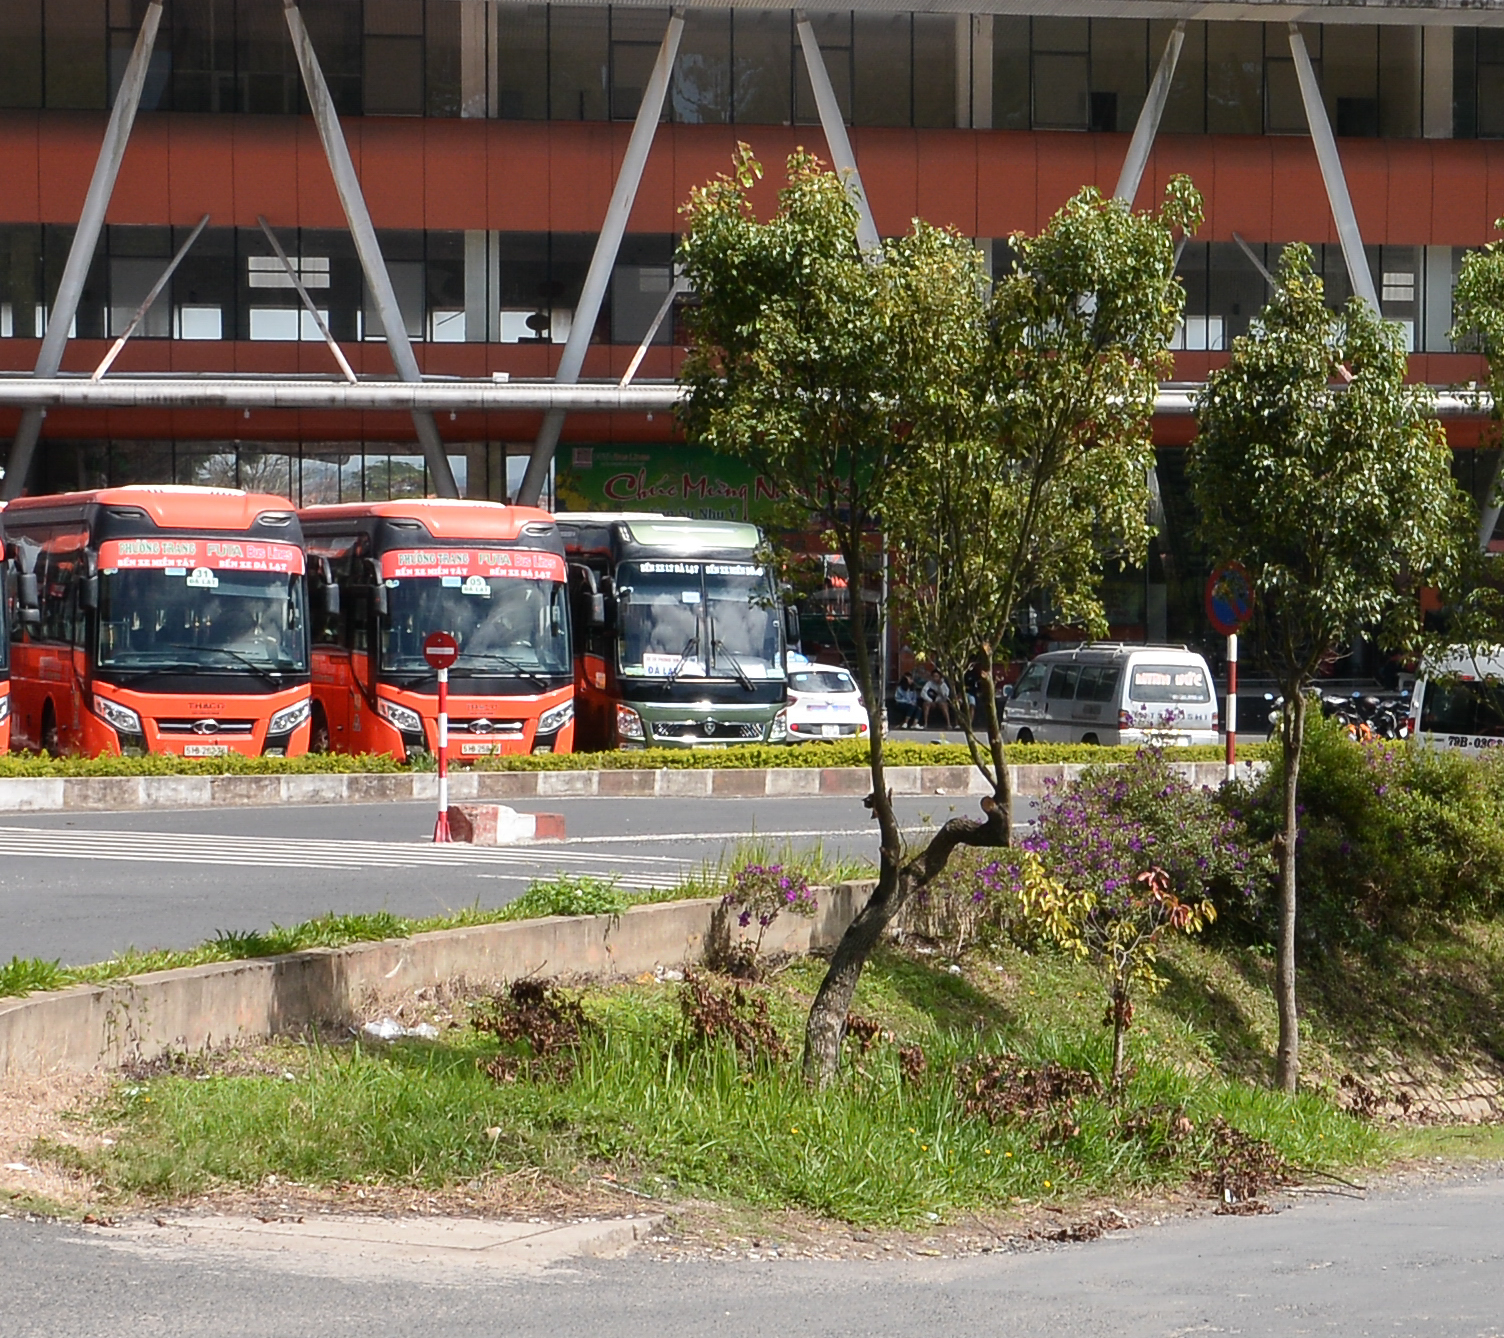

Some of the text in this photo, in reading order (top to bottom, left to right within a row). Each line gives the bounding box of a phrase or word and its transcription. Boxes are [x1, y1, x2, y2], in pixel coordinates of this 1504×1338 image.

[603, 467, 678, 501] Chúc
[682, 473, 748, 521] Mừng
[161, 541, 196, 555] TRANG
[207, 543, 293, 560] FUTA Bus Lines
[437, 552, 469, 565] TRANG
[478, 552, 512, 566] FUTA
[197, 569, 209, 578] 31
